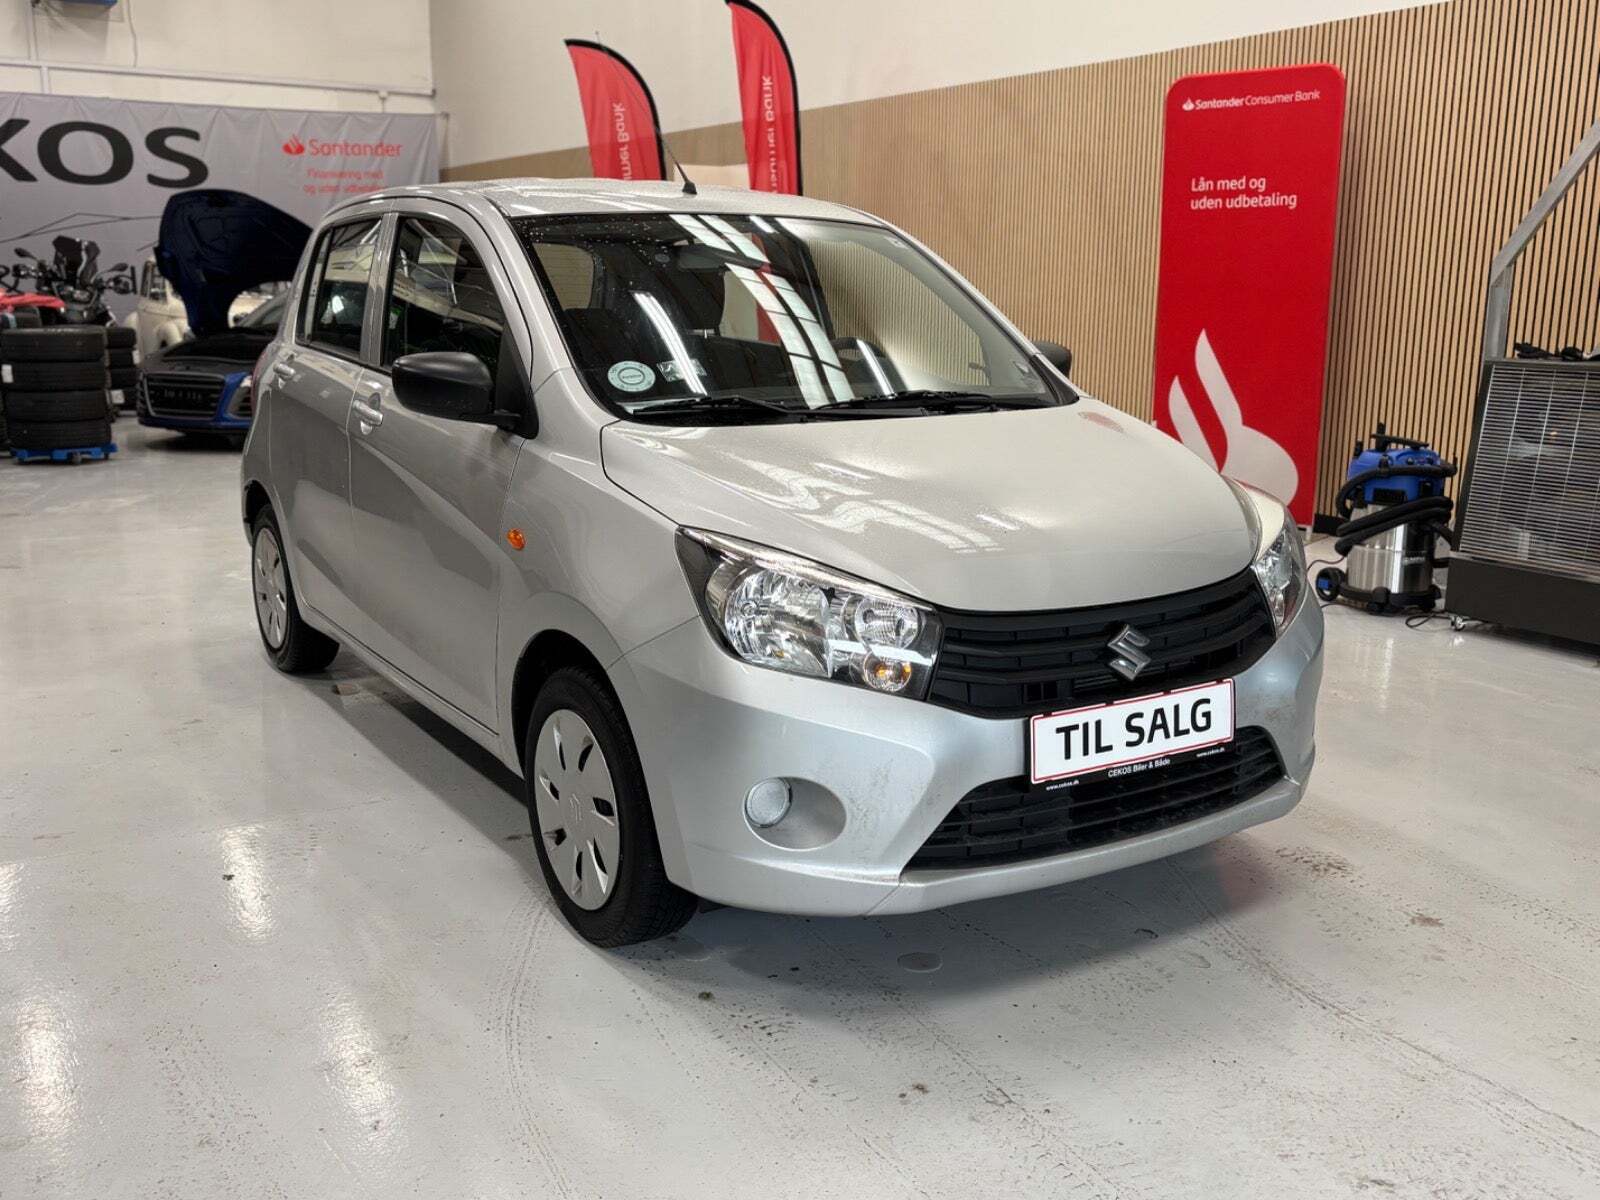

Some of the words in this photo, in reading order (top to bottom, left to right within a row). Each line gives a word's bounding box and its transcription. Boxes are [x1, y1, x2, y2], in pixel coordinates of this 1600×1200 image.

[1195, 97, 1244, 110] Santander
[1245, 92, 1294, 106] Consumer
[1295, 89, 1321, 101] Bank
[308, 138, 402, 157] Santander
[1191, 177, 1214, 192] Lån
[1217, 176, 1246, 190] med
[1249, 177, 1266, 192] og
[1191, 196, 1222, 210] uden
[1226, 192, 1297, 209] udbetaling
[1056, 719, 1113, 760] TIL
[1125, 698, 1211, 747] SALG
[1108, 765, 1132, 778] CEKOS
